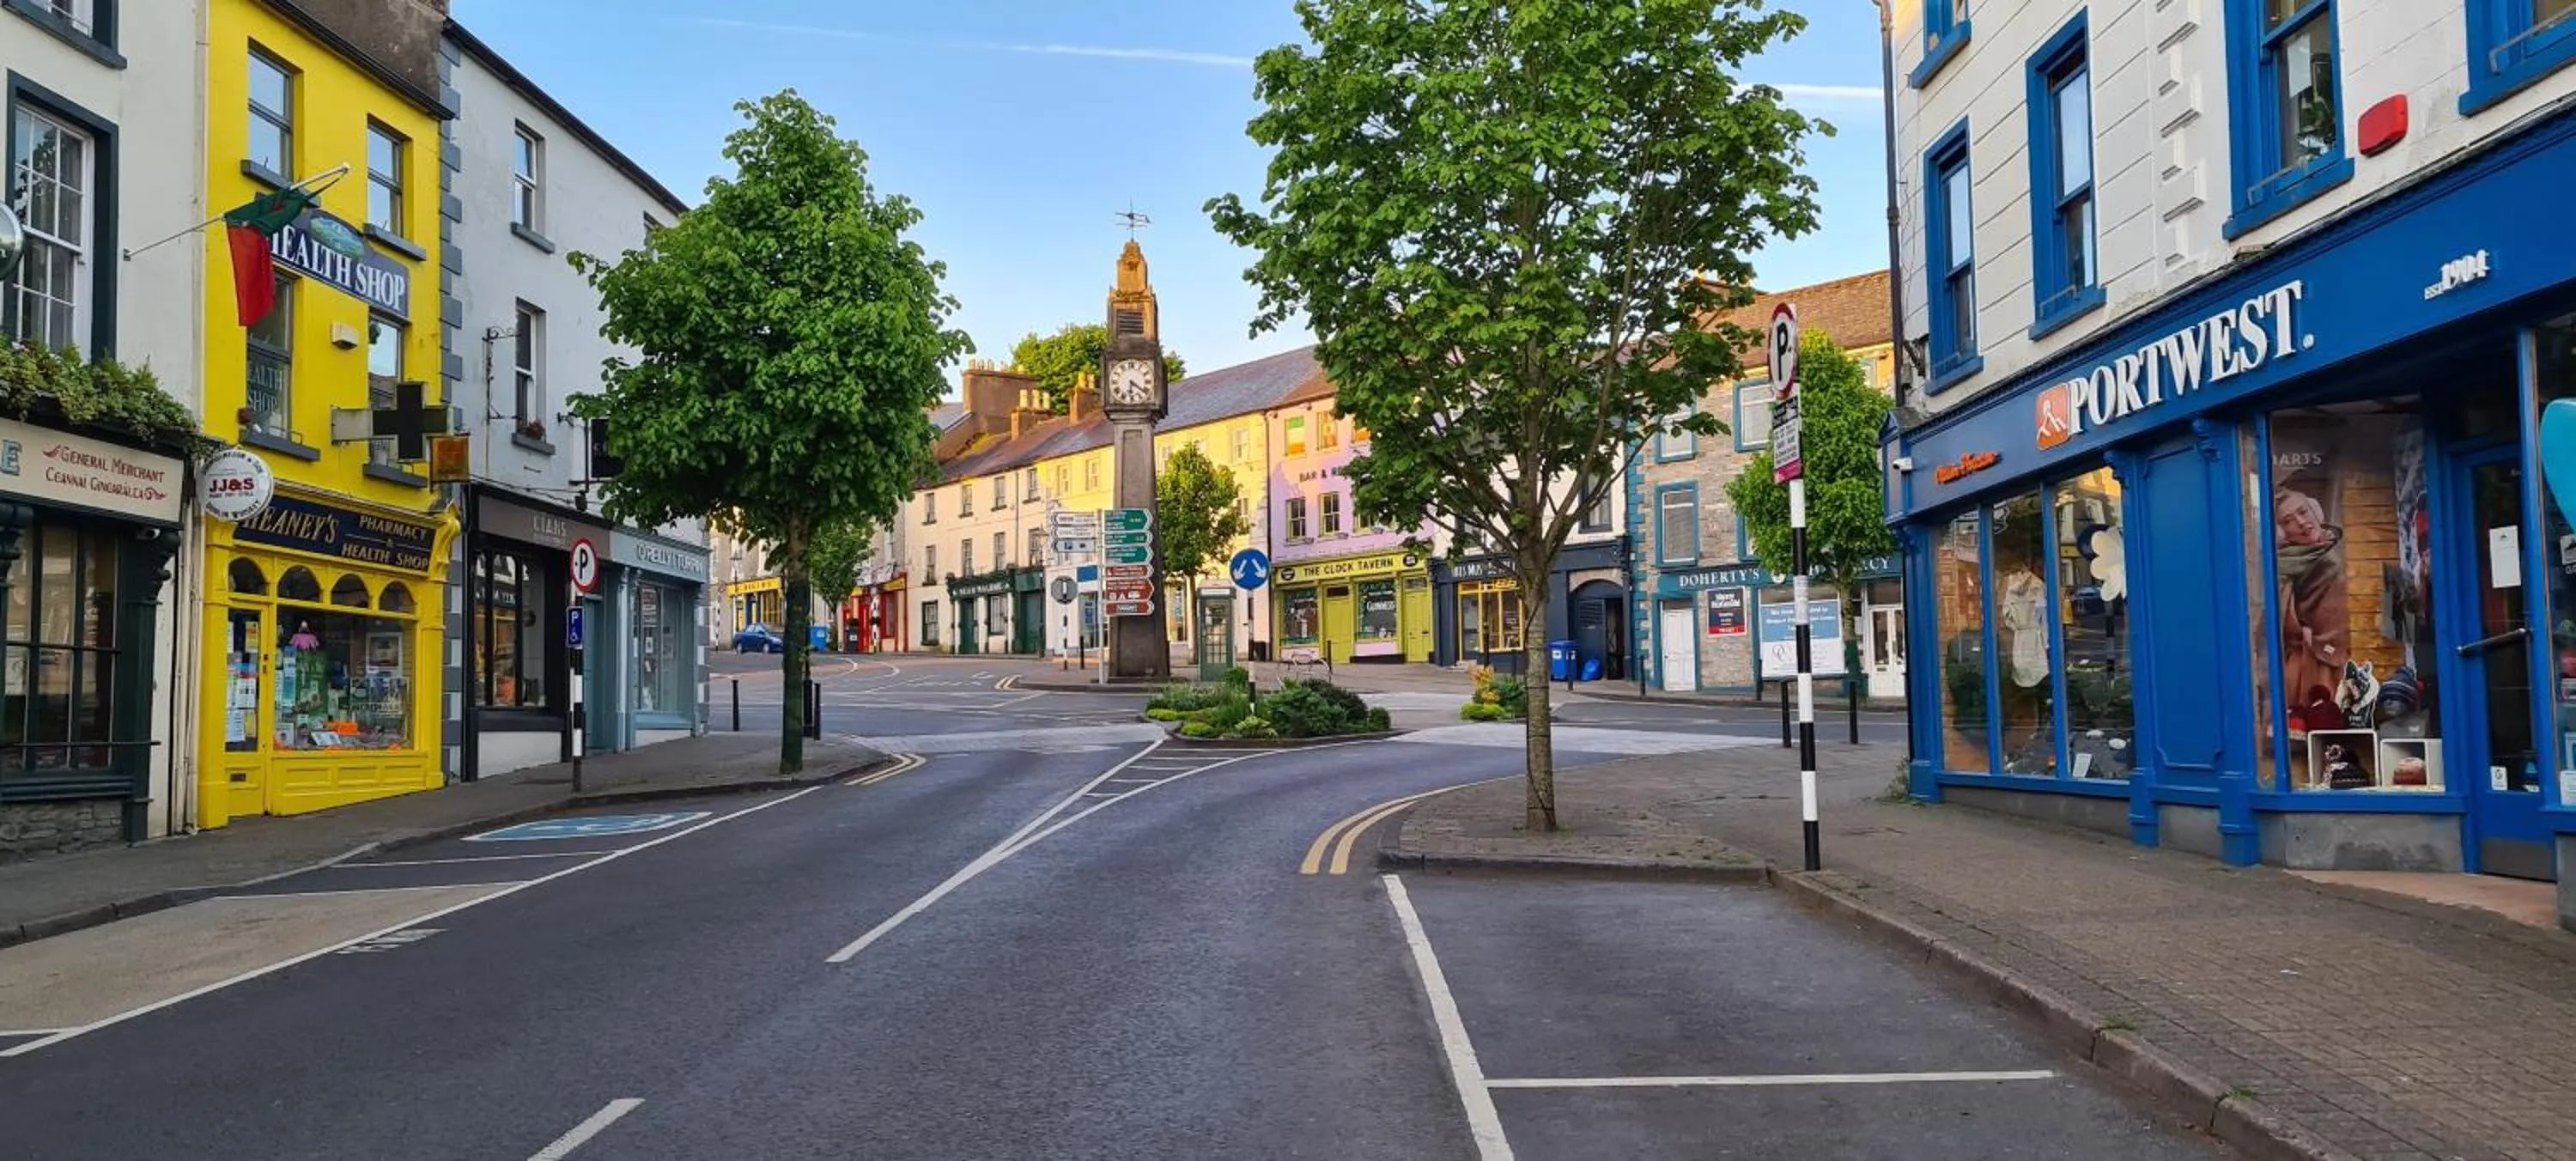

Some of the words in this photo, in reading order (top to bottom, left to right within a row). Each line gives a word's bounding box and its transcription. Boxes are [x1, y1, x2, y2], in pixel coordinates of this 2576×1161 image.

[2441, 249, 2490, 289] 1904
[355, 263, 404, 311] SHOP
[60, 446, 108, 471] GENERAL
[112, 458, 165, 483] MERCHANT
[1299, 471, 1317, 483] BAR
[209, 478, 254, 493] JJ&S
[359, 514, 428, 541] PHARMACY
[342, 542, 389, 563] HEALTH
[397, 552, 428, 569] SHOP
[580, 548, 588, 580] P
[1304, 568, 1319, 576] THE
[1324, 562, 1354, 574] CLOCK
[1358, 558, 1393, 570] TAVERN
[1679, 568, 1759, 587] DOHERTY'S
